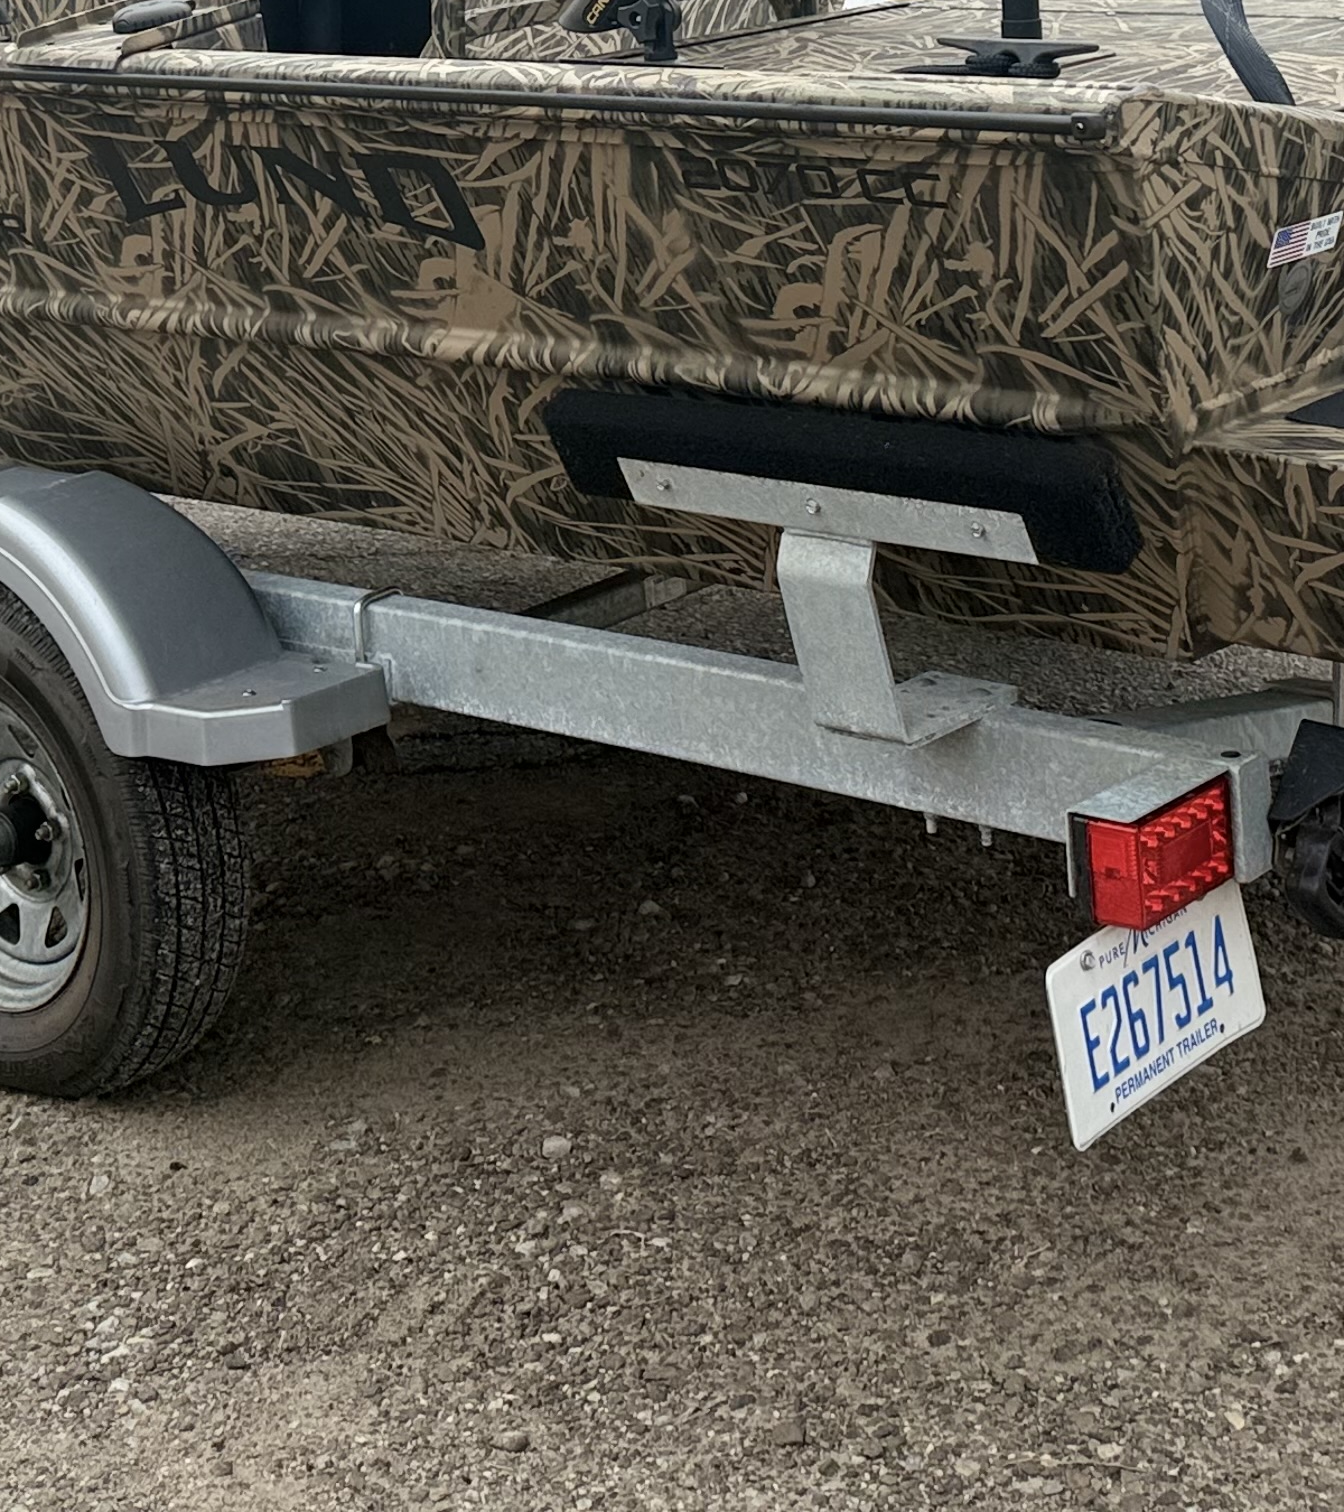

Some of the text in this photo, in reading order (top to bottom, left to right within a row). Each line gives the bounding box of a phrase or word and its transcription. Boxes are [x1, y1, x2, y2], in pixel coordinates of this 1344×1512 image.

[86, 137, 485, 251] LUND
[1079, 914, 1234, 1094] E267514
[1098, 940, 1127, 969] PURE
[1114, 1017, 1219, 1104] PERMANENT TRAILER
